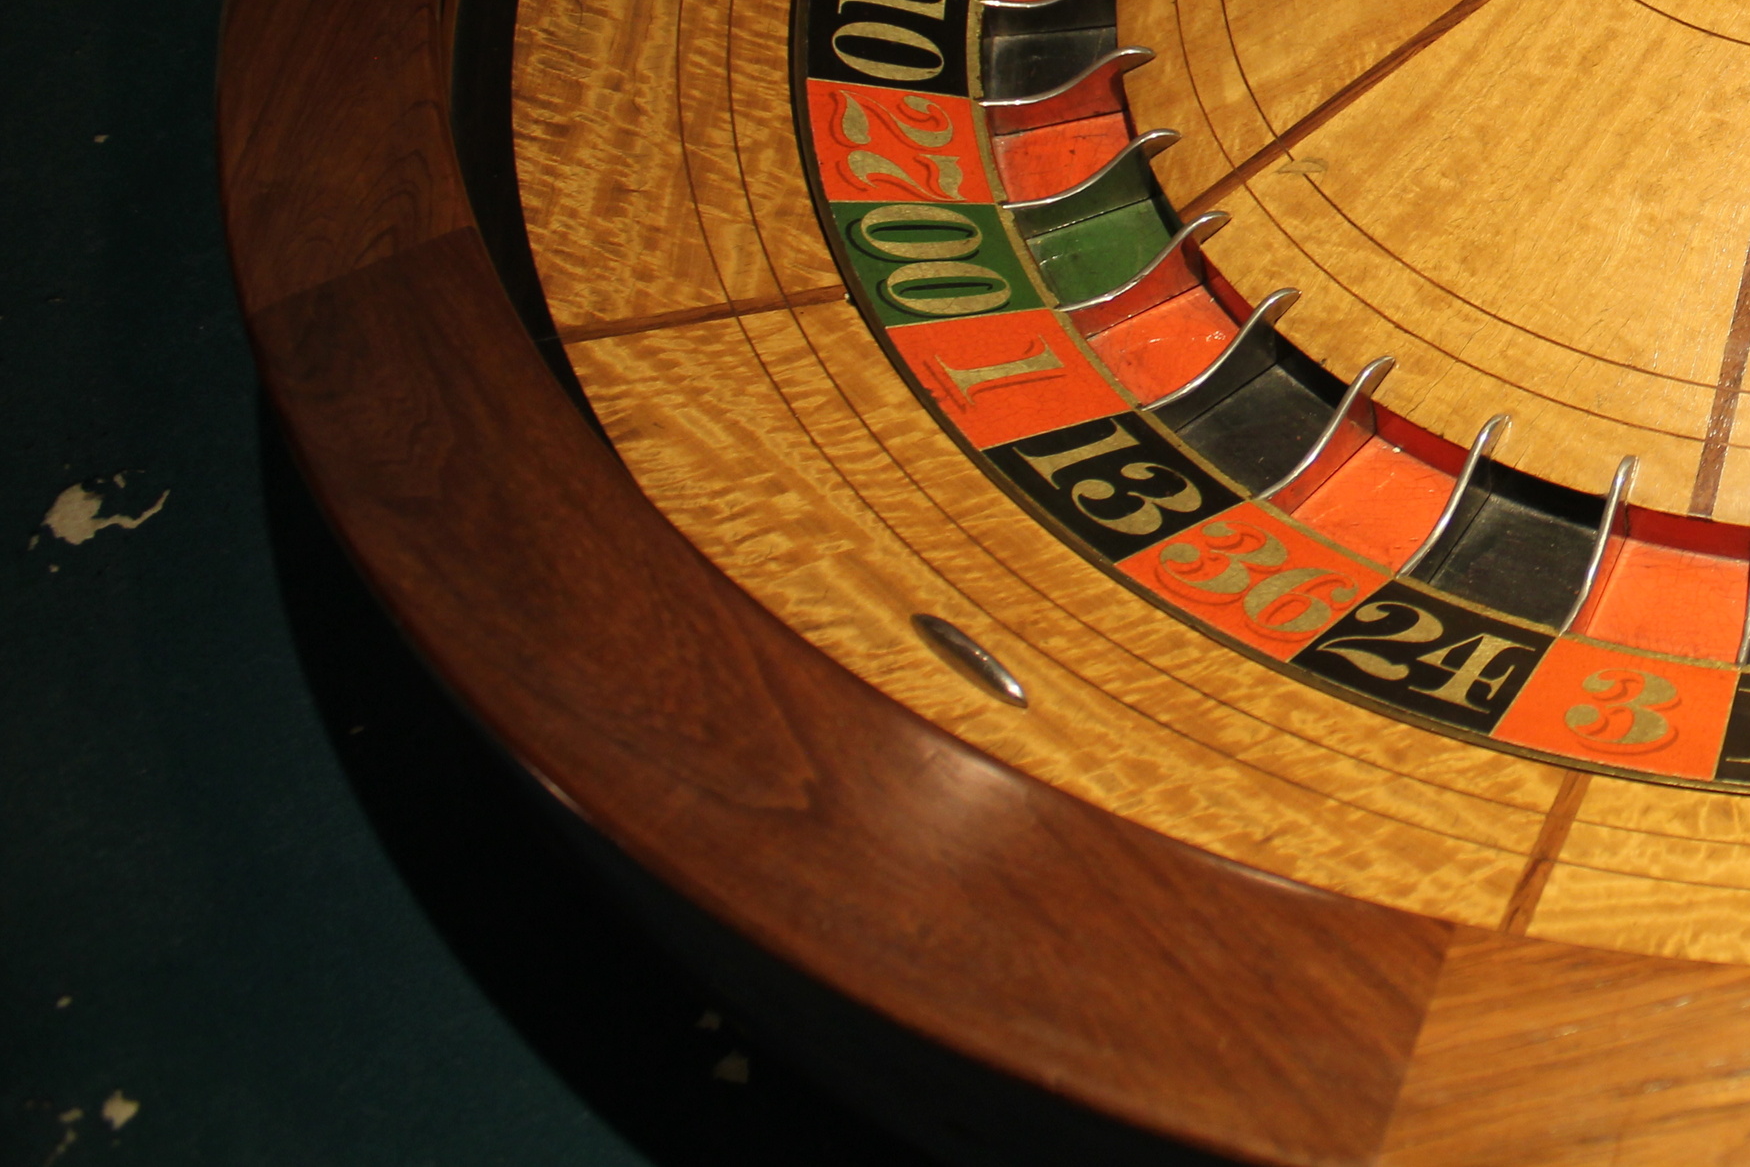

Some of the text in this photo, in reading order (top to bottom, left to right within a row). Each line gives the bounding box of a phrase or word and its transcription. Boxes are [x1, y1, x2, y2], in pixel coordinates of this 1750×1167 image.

[840, 90, 966, 201] 27
[860, 204, 1011, 315] 00
[935, 335, 1064, 405] 1
[1012, 418, 1202, 535] 13
[1159, 520, 1360, 632] 36
[1316, 601, 1536, 712] 24
[1564, 668, 1678, 744] 3
